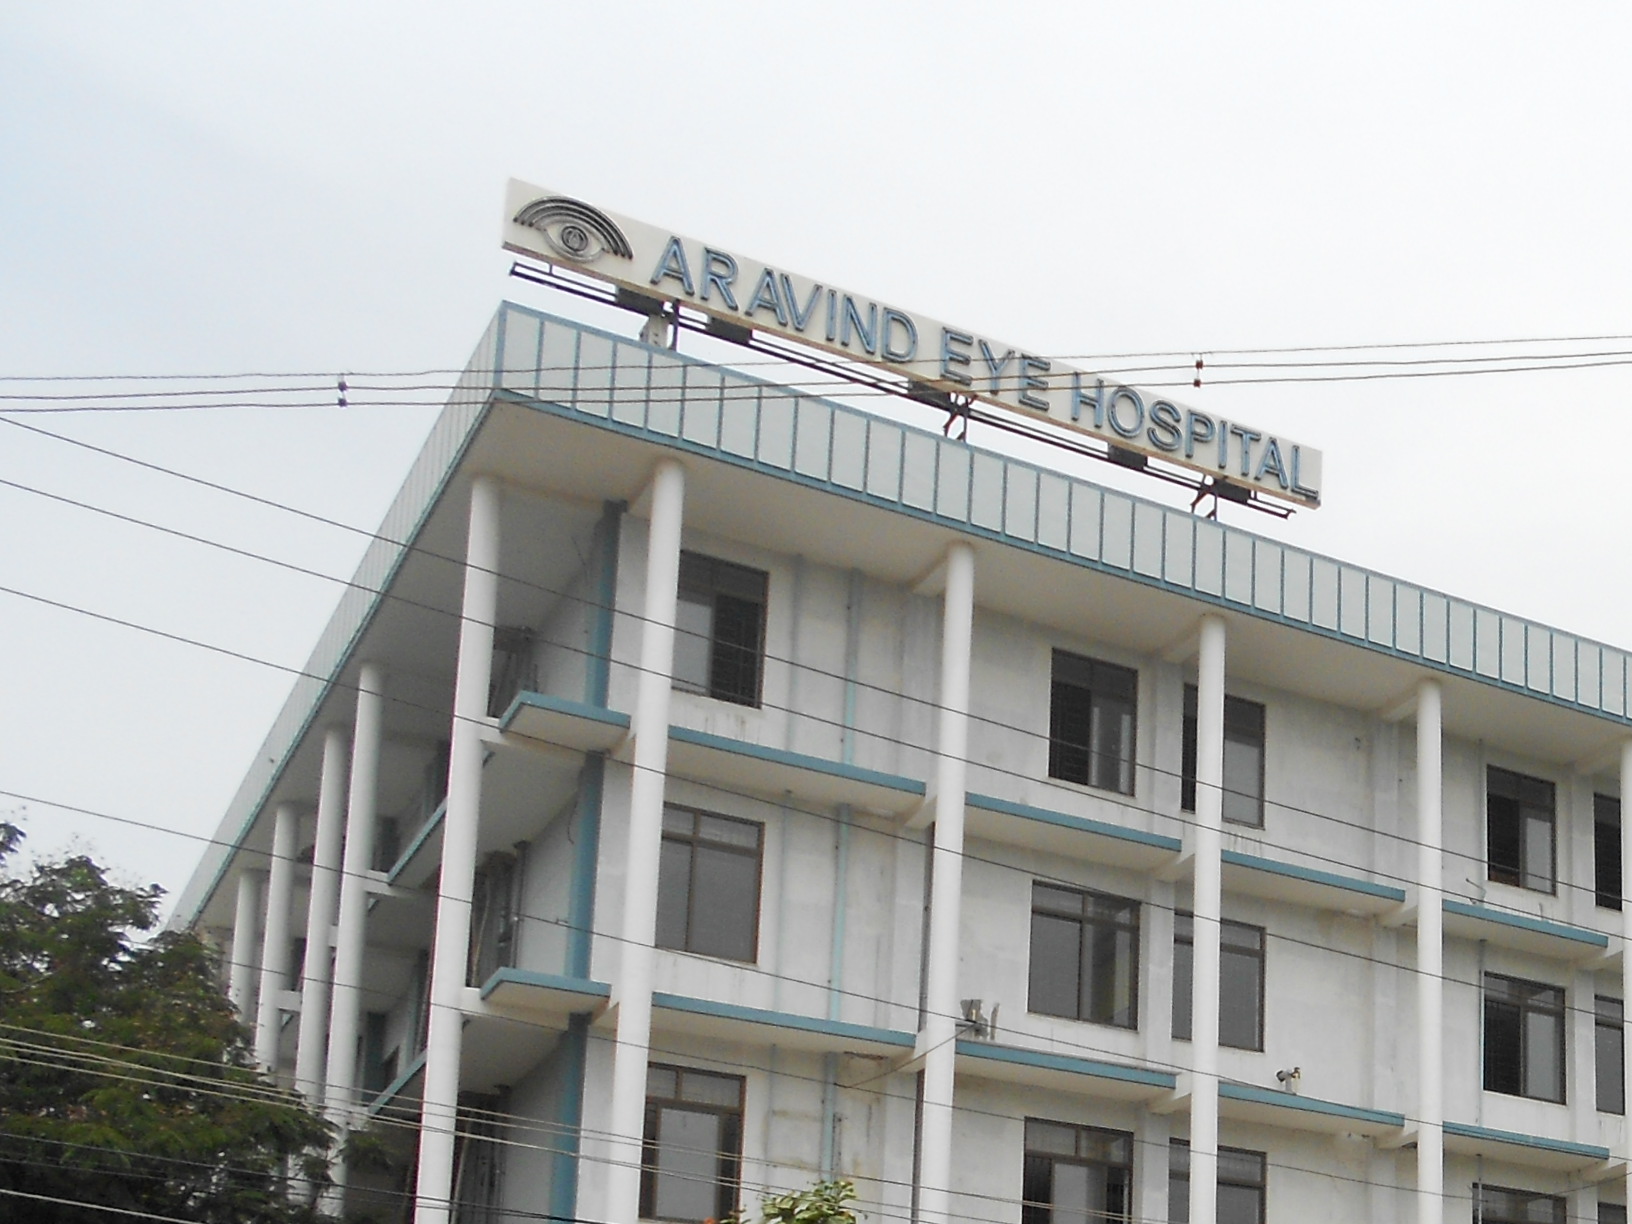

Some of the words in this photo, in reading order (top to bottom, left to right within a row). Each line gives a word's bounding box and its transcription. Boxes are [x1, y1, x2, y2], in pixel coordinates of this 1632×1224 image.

[651, 235, 918, 365] ARAVIND
[940, 326, 1051, 411] EYE
[1070, 370, 1319, 500] HOSPITAL
